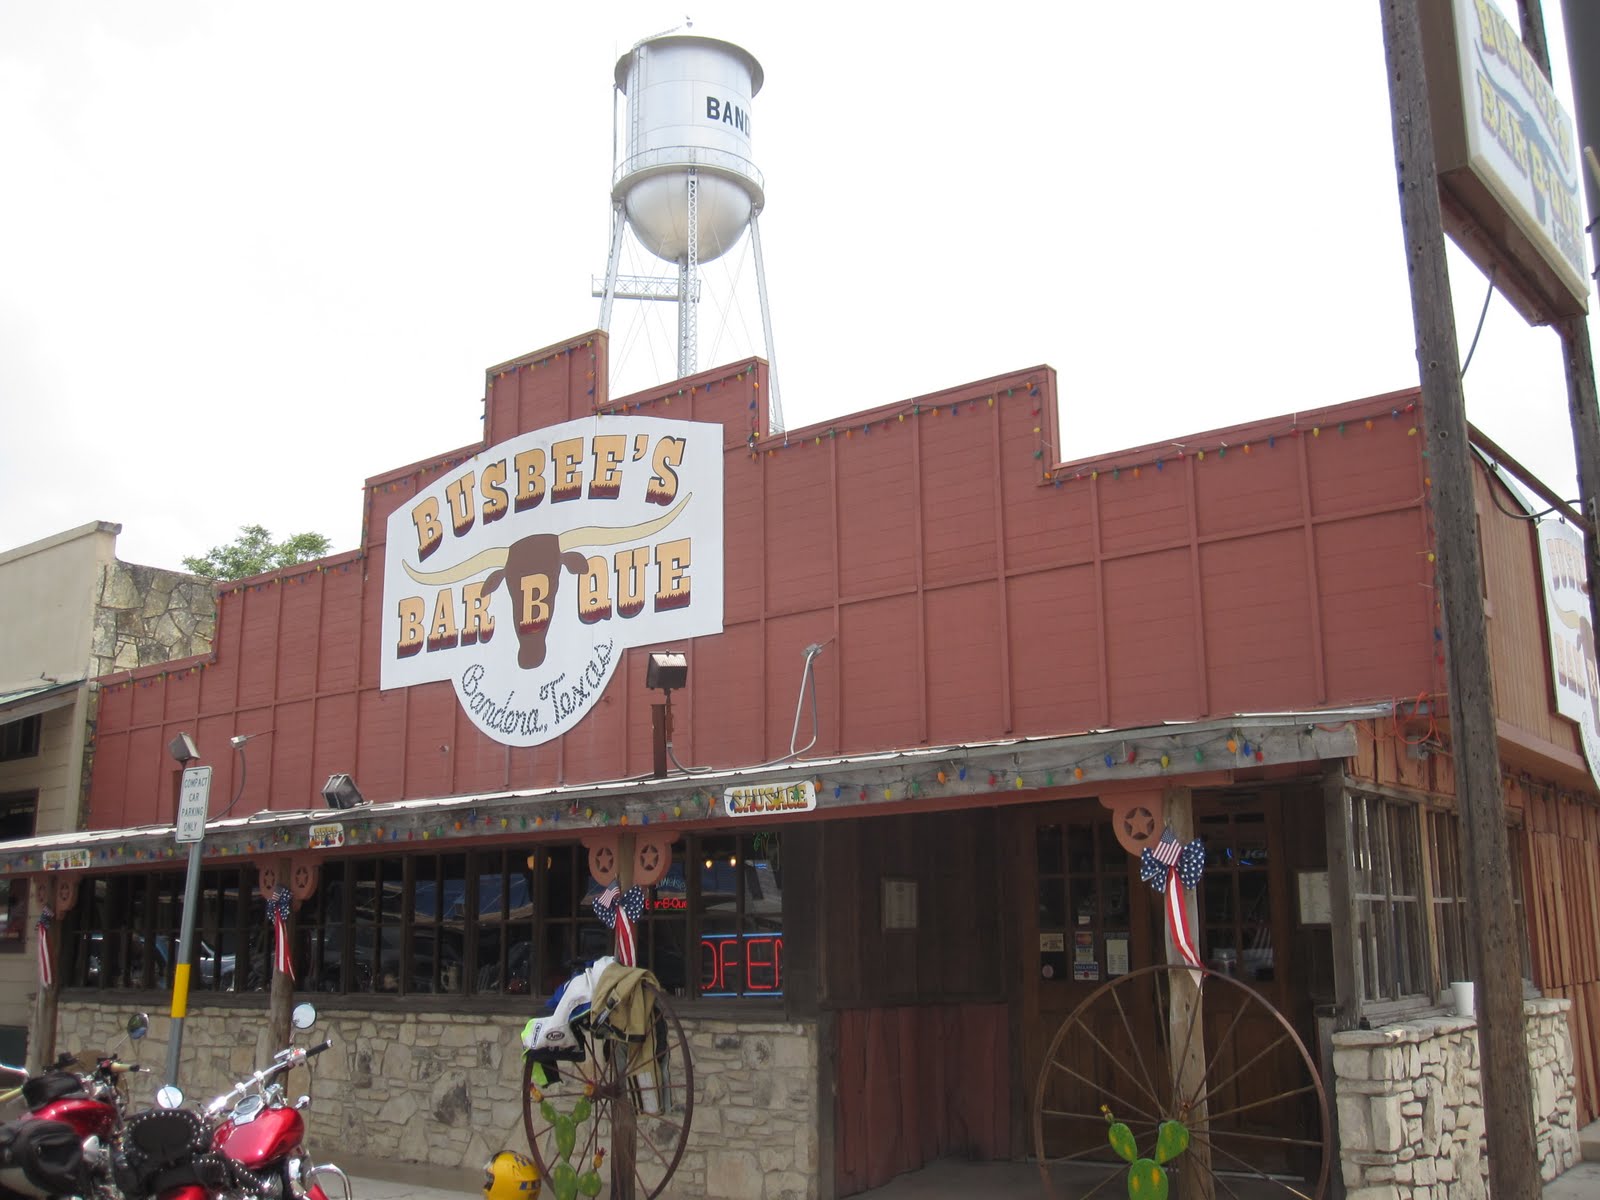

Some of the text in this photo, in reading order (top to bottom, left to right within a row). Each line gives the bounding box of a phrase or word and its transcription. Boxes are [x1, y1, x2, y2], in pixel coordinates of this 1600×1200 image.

[411, 434, 687, 562] BUSBEE'S
[397, 537, 692, 659] BAR B QUE
[539, 638, 614, 724] Texas
[184, 777, 208, 788] COMPACT
[189, 793, 200, 802] CAR
[181, 806, 204, 816] PARKING
[183, 822, 198, 832] ONLY
